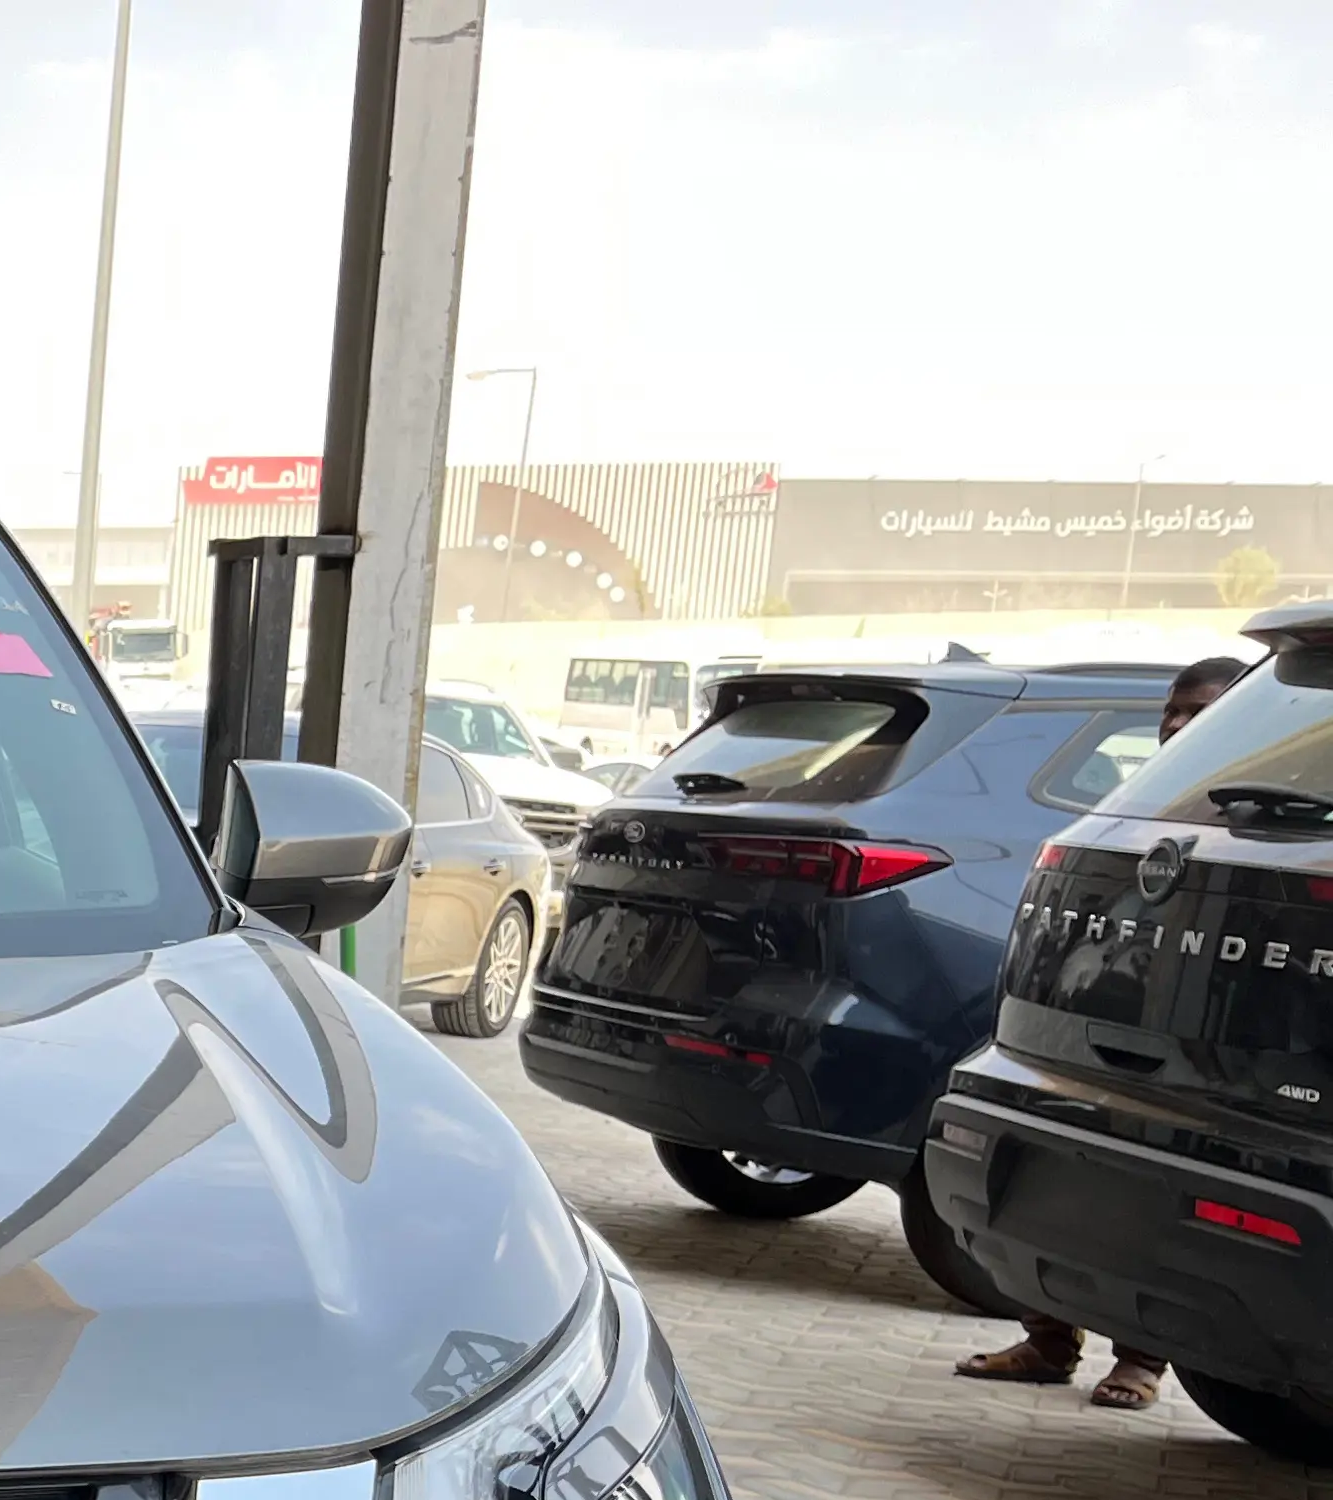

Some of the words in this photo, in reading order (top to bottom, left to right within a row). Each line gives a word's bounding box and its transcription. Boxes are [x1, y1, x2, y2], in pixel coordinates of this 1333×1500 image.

[880, 509, 974, 538] للسيارات
[982, 507, 1051, 536] مشيط
[1055, 509, 1127, 538] خميس
[1131, 504, 1194, 538] أضواء
[1196, 505, 1255, 538] شركة
[1021, 902, 1333, 976] PATHFINDER
[1276, 1084, 1321, 1103] 4WD
